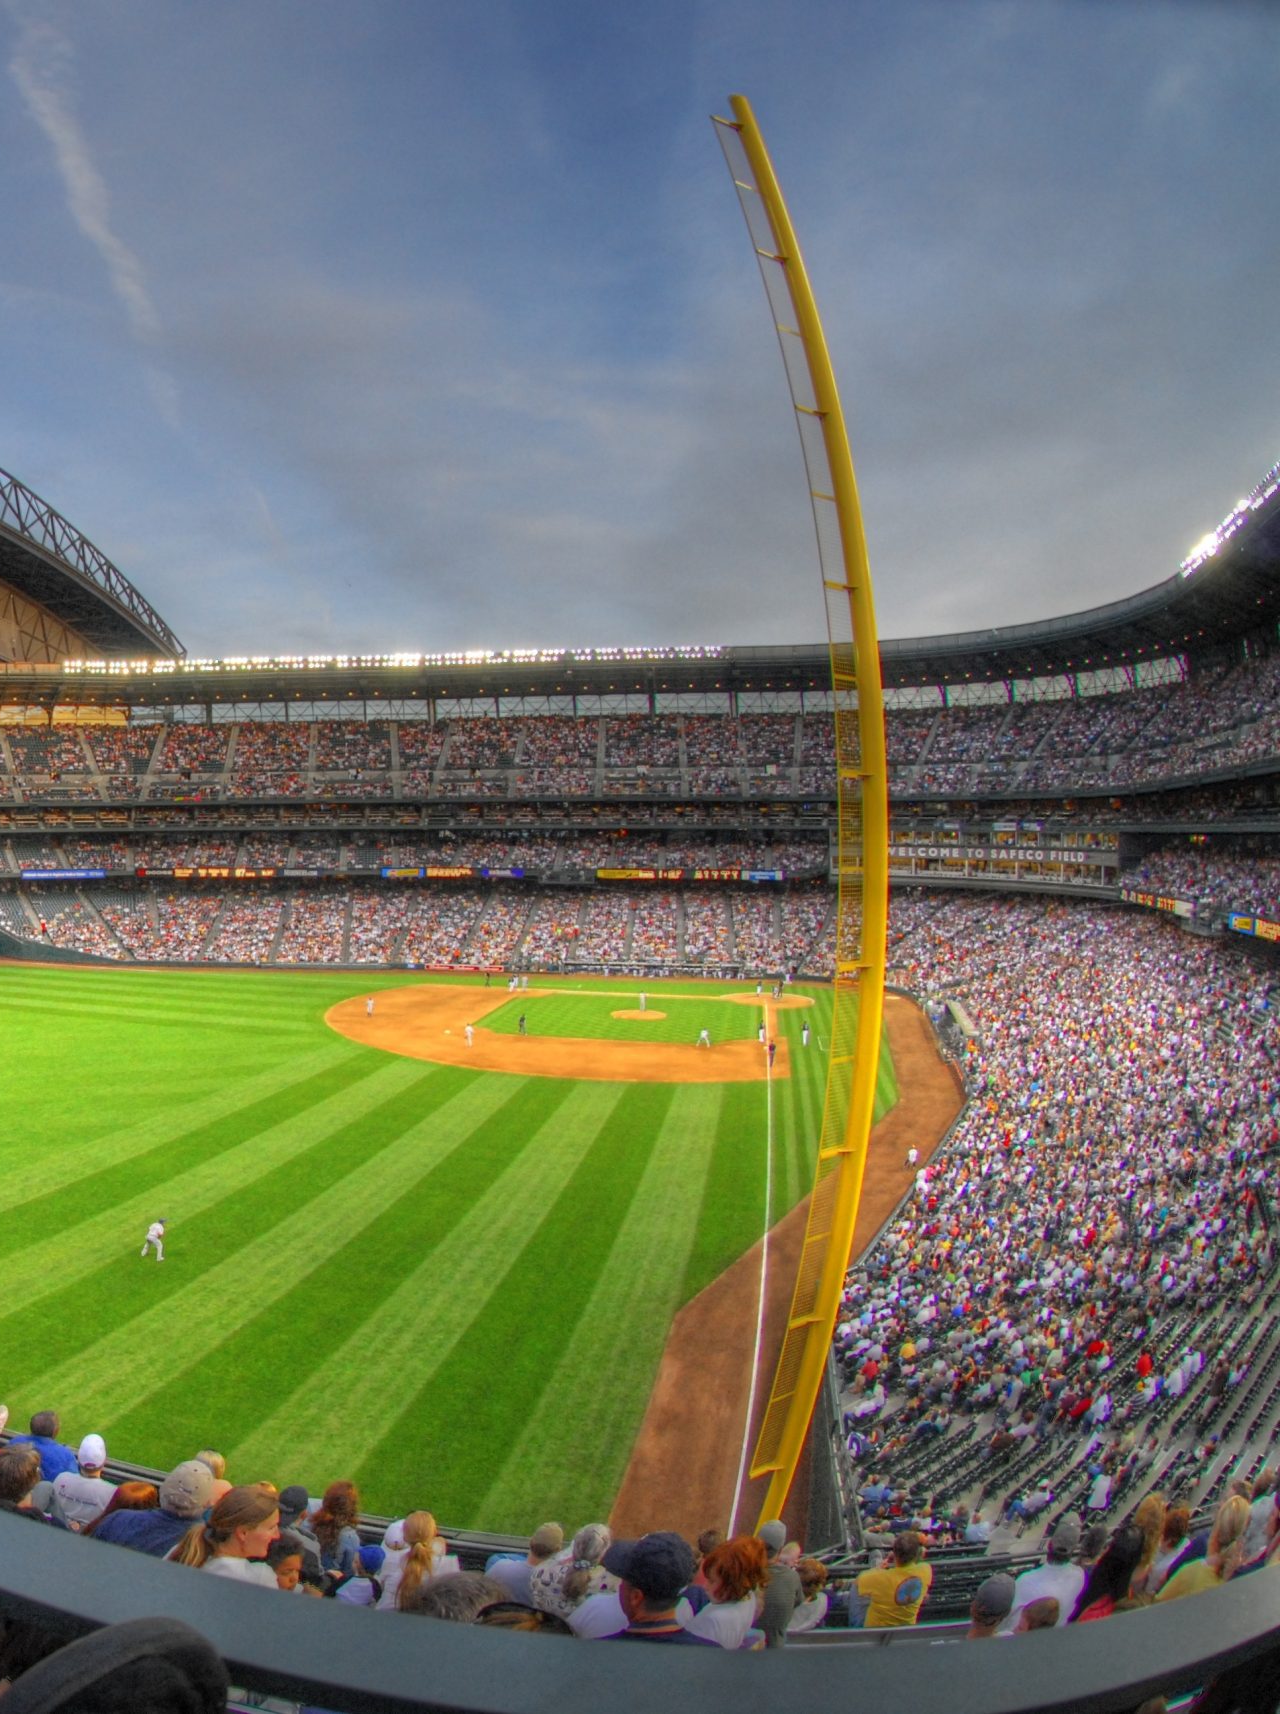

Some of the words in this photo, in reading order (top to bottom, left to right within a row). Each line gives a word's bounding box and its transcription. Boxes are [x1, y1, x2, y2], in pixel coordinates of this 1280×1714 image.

[888, 847, 959, 858] WELCOME
[966, 848, 984, 858] TO
[990, 849, 1044, 861] SAFECO
[1050, 850, 1085, 863] FIELD
